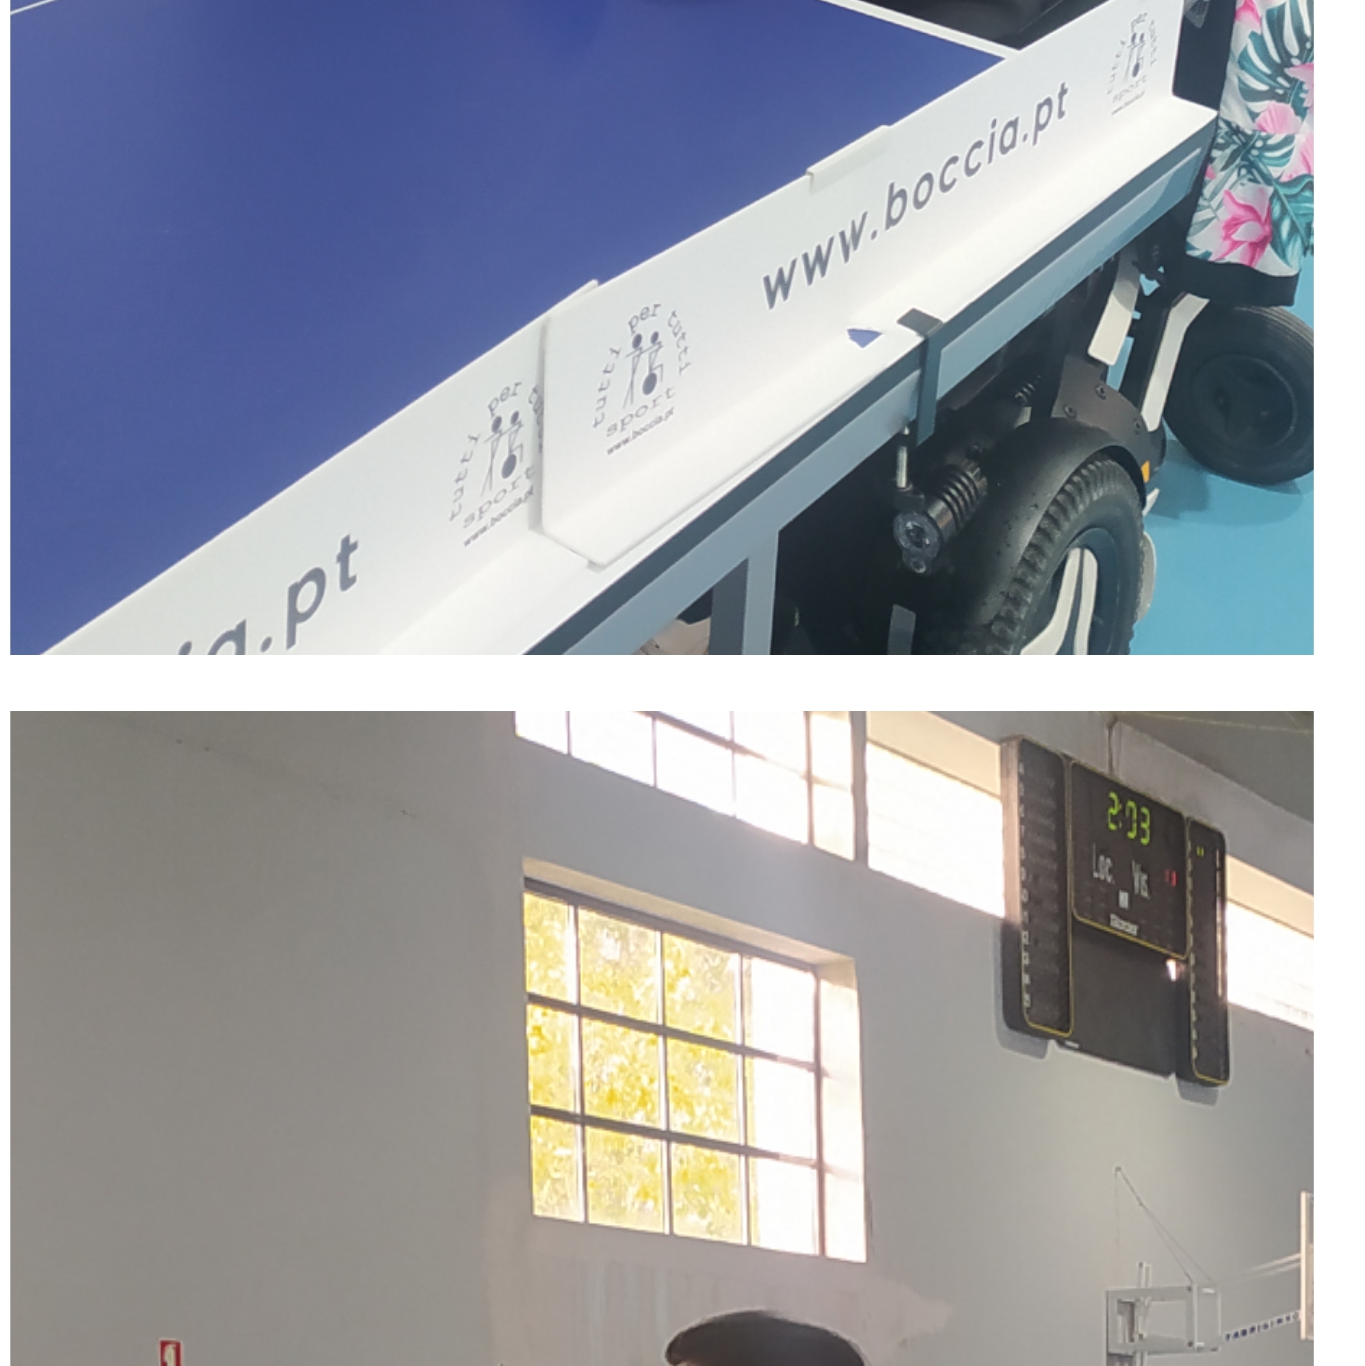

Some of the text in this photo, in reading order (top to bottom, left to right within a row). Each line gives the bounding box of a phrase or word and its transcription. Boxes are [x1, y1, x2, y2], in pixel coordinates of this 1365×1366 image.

[762, 82, 1068, 309] www.boccia.pt
[627, 303, 661, 334] per
[487, 381, 522, 418] per
[606, 386, 675, 437] sport
[463, 465, 535, 529] sport
[178, 534, 359, 656] .pt
